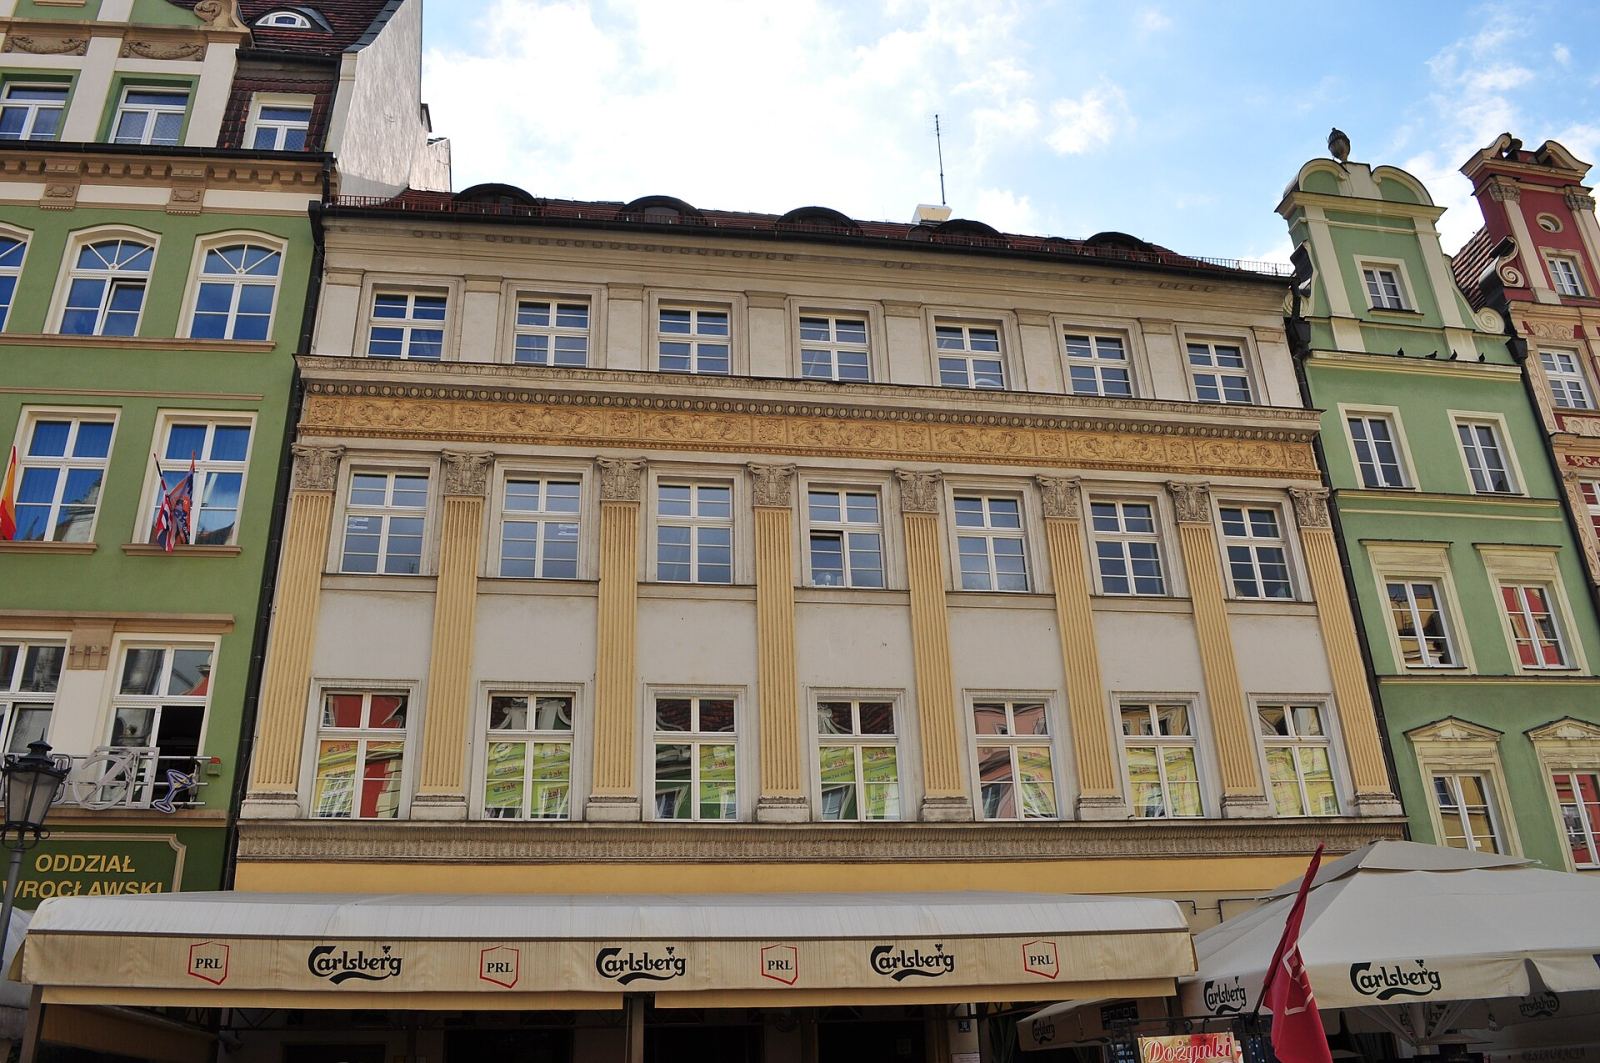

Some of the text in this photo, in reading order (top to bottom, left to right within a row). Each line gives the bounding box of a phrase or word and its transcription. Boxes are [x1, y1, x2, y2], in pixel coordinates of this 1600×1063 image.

[35, 854, 136, 873] ODDZIAŁ
[195, 958, 223, 969] PRL
[308, 946, 402, 978] Carlsberg
[487, 962, 513, 973] PRL
[596, 948, 686, 979] Carlsberg
[767, 960, 793, 971] PRL
[870, 945, 955, 976] Carlsberg
[1029, 954, 1054, 966] PRL
[1350, 962, 1441, 996] Carlsberg
[1203, 980, 1247, 1011] Carlsberg
[1143, 1036, 1231, 1063] Dożynki
